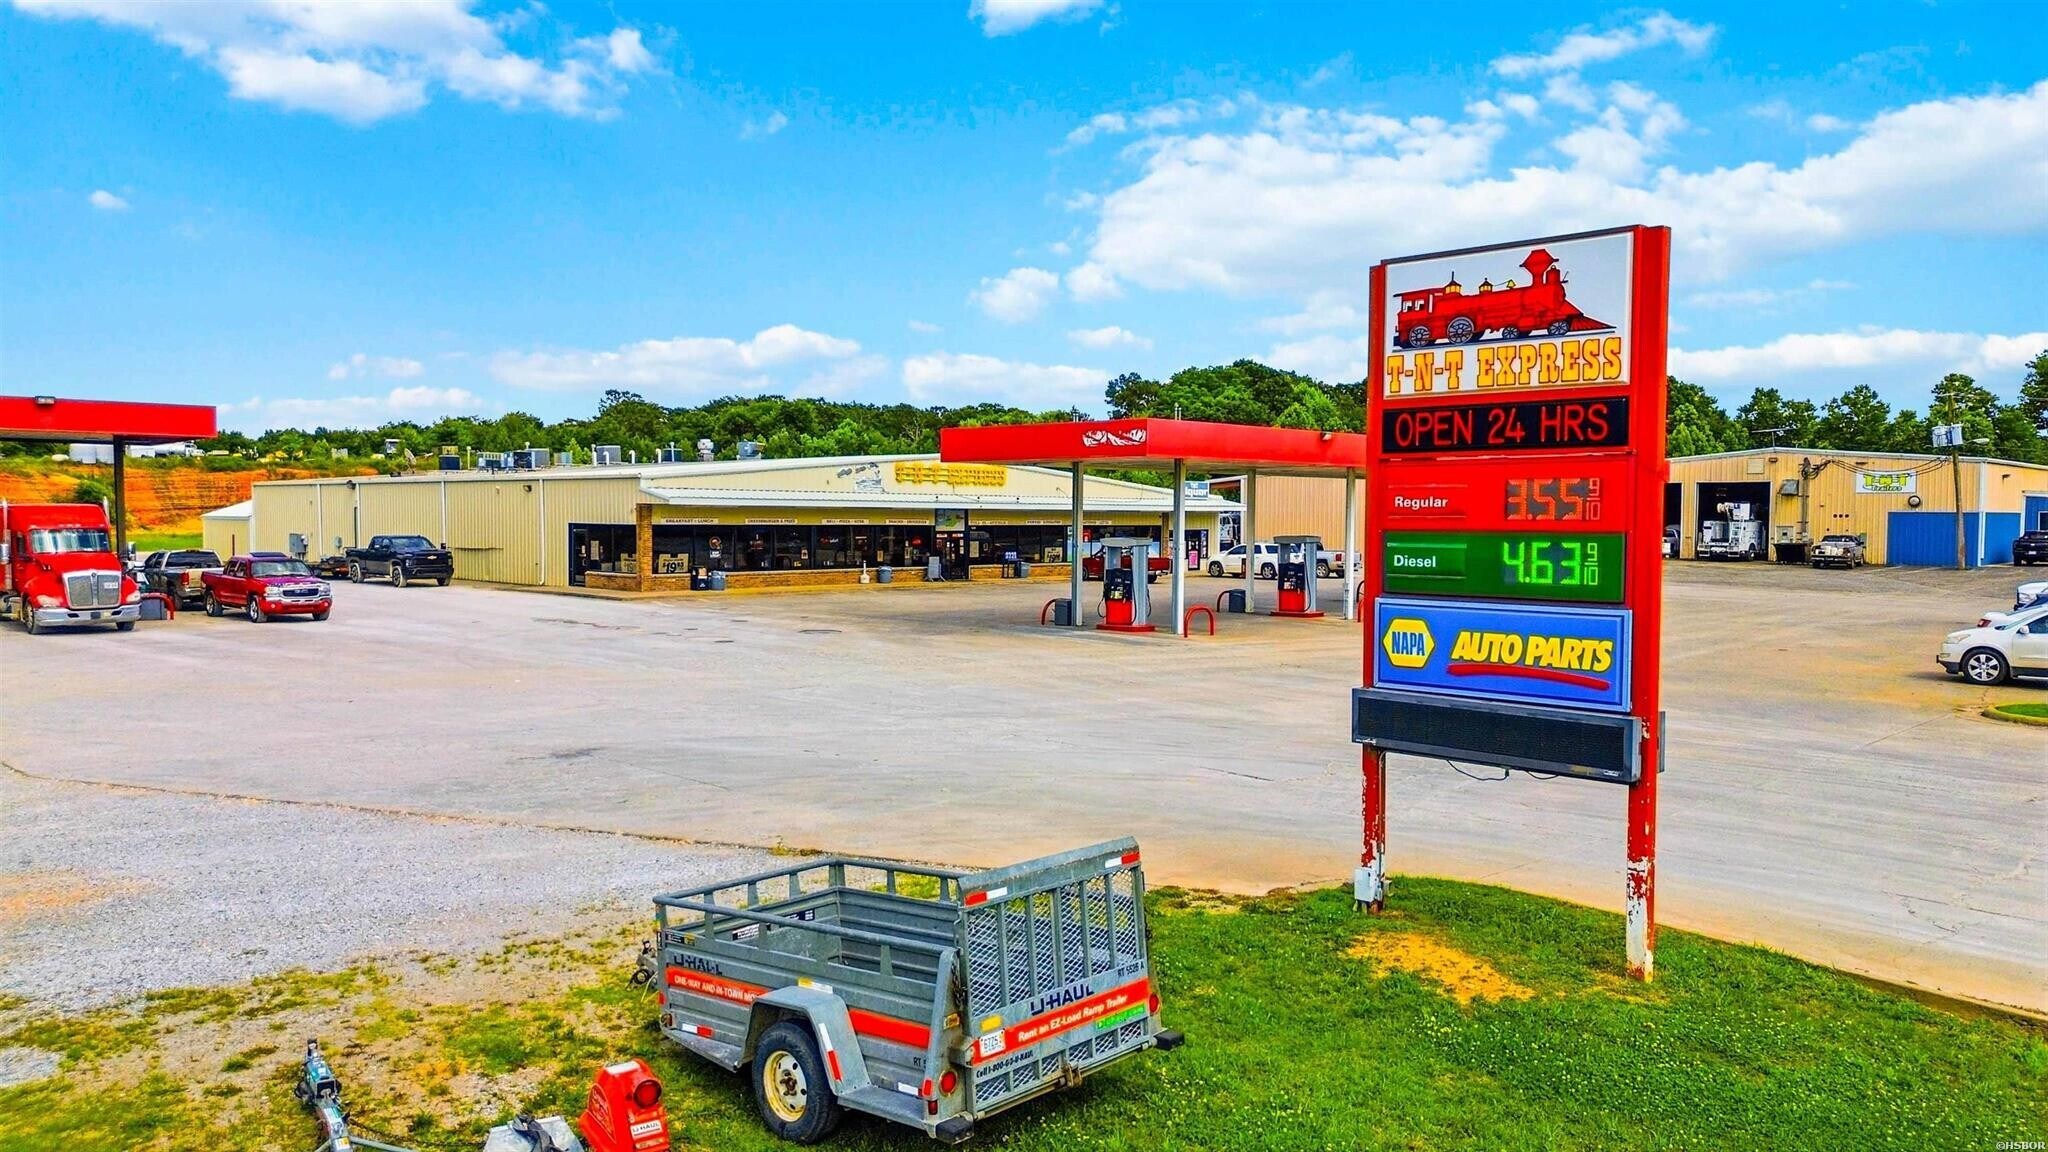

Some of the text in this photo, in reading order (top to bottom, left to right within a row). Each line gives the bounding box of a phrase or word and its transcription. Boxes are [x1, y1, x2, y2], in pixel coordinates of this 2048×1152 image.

[1387, 337, 1622, 394] T-N-T EXPRESS
[1395, 404, 1608, 447] OPEN 24 HRS
[1394, 496, 1448, 511] Regular
[1393, 555, 1437, 568] Diesel
[1503, 542, 1581, 585] 4.63
[1391, 630, 1426, 657] NAPA
[1451, 630, 1613, 673] AUTO PARTS
[1018, 1028, 1038, 1042] Rent
[1050, 1010, 1082, 1029] EZ-Load
[1083, 1003, 1105, 1018] Ramp
[1106, 994, 1128, 1008] Trailer
[1030, 983, 1095, 1017] U-HAUL
